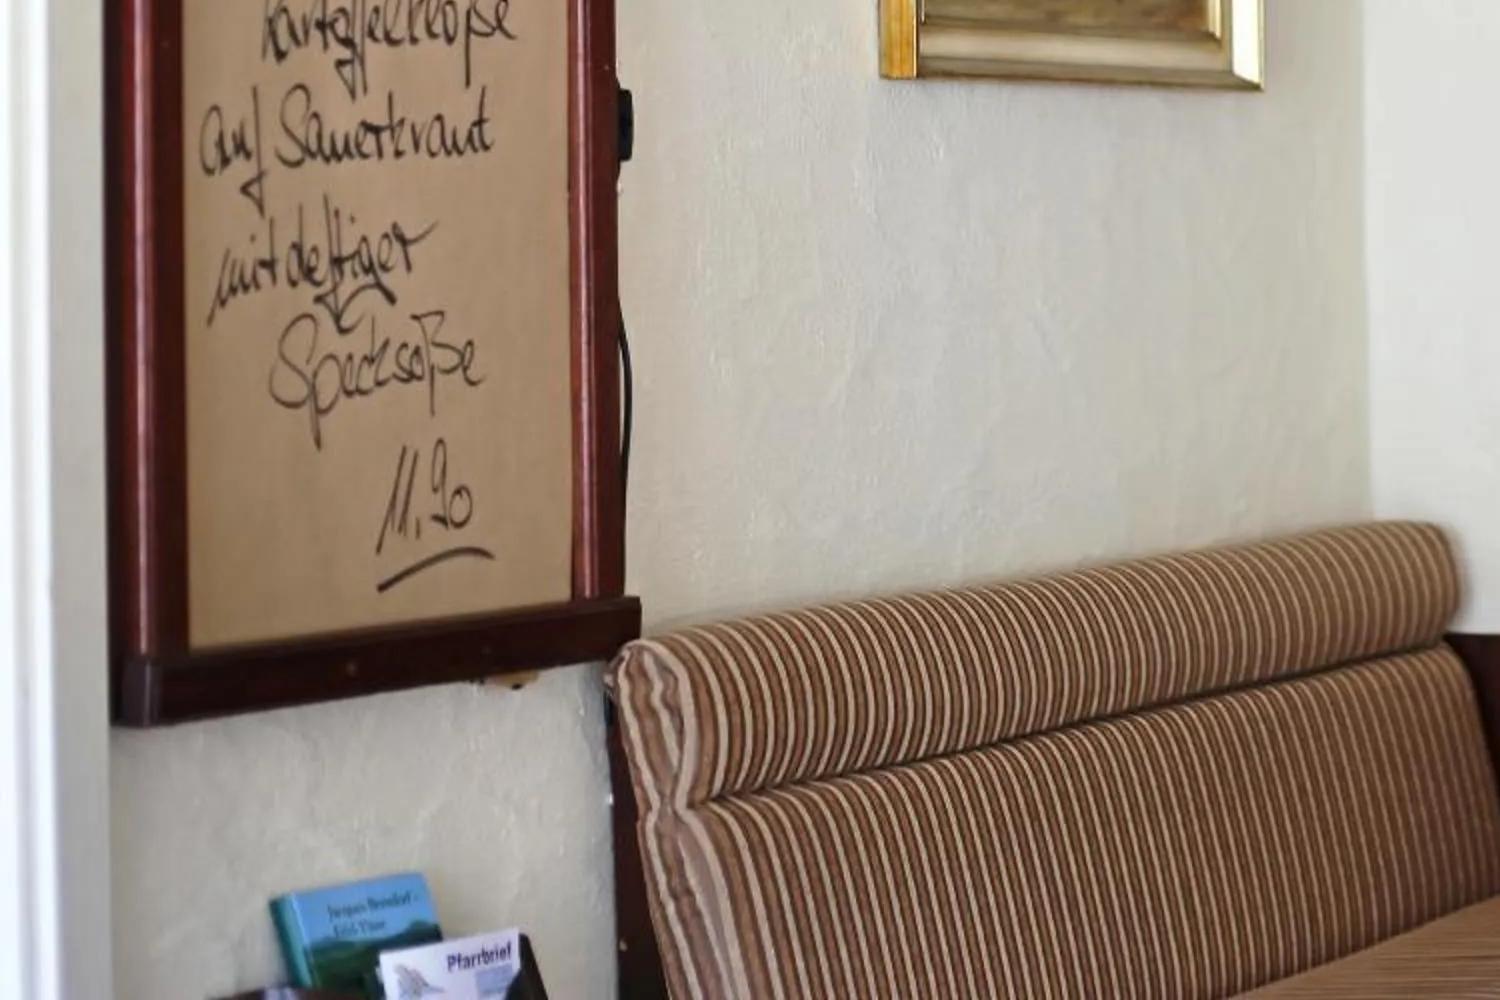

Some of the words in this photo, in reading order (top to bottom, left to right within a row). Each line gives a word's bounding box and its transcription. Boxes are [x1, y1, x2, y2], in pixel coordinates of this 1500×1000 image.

[275, 83, 496, 171] Sauerkraut
[206, 214, 282, 328] mit
[287, 193, 441, 336] deftiger
[269, 310, 488, 453] Specksoße
[447, 942, 512, 972] Pfarrbrief
